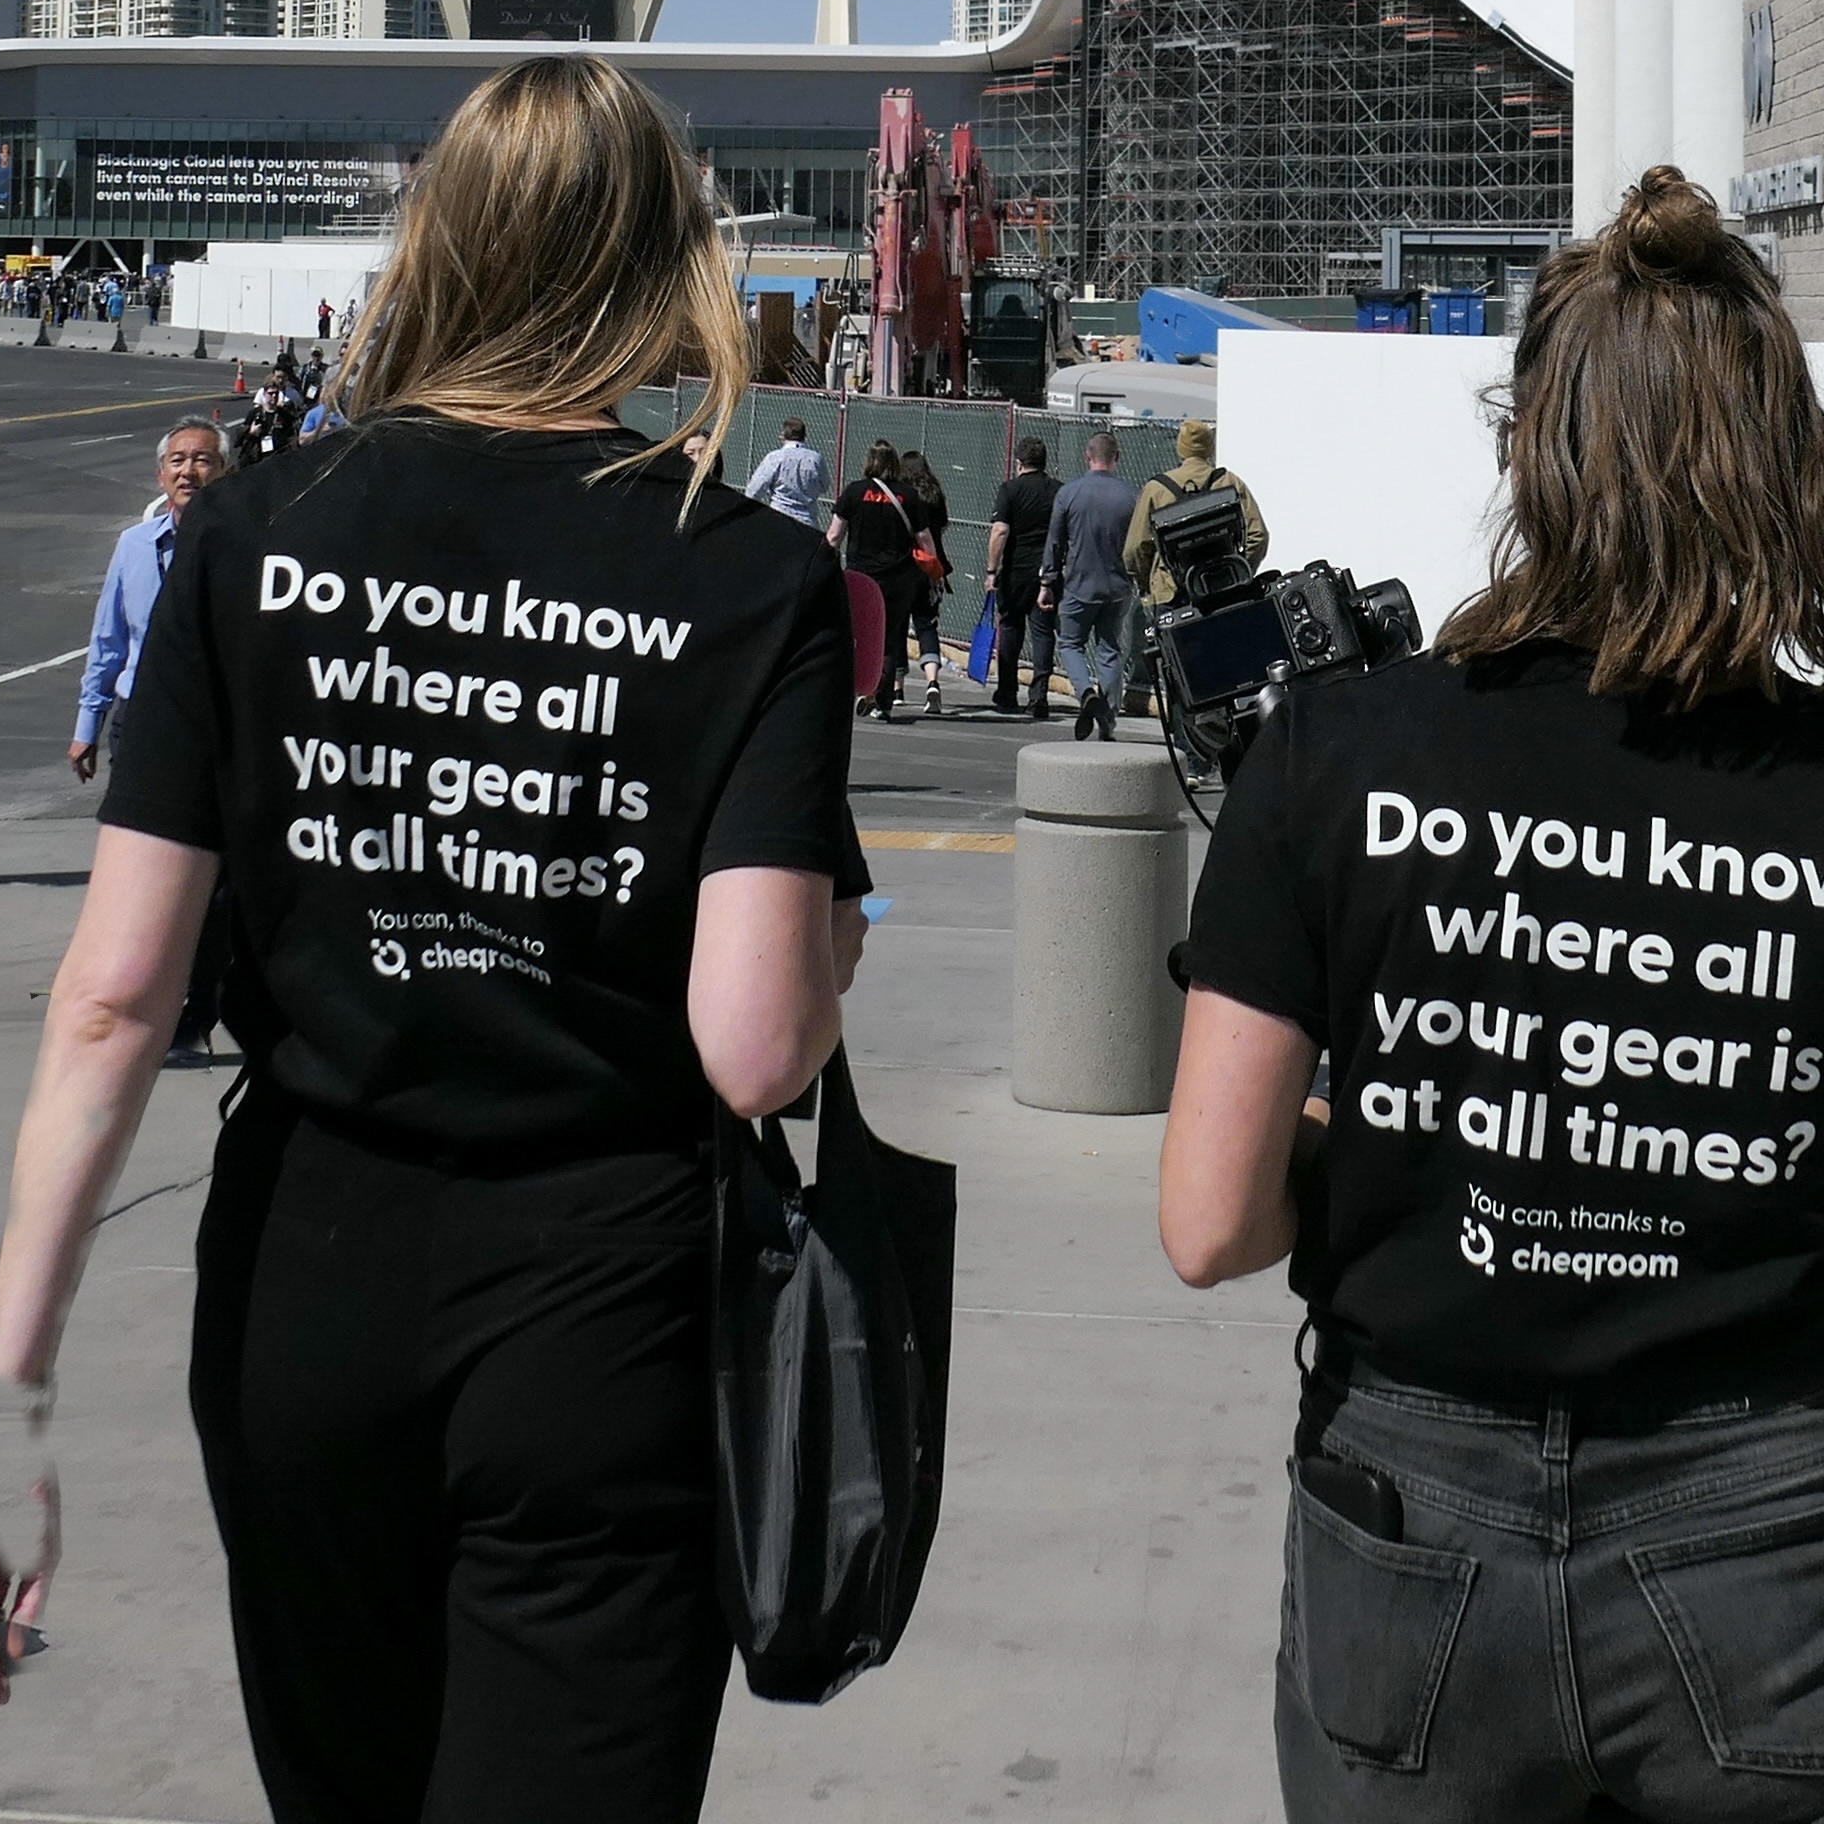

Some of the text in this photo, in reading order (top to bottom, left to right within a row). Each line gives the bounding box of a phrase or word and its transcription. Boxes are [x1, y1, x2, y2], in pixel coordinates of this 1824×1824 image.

[96, 154, 368, 173] Blackmagic Cloud lets you sync media
[96, 169, 370, 187] live from cameras to DaVinci Resolve
[96, 188, 360, 208] even while the camera is recording!
[259, 554, 692, 661] Do you know
[307, 646, 620, 735] where all
[283, 736, 650, 821] your gear is
[287, 813, 645, 904] at all times?
[1366, 790, 1467, 856] Do
[1488, 811, 1626, 877] you
[367, 908, 408, 931] You
[412, 913, 455, 933] can,
[522, 936, 545, 957] to
[421, 941, 551, 985] cheqroom
[1425, 892, 1796, 1001] where all
[1374, 991, 1824, 1093] your gear is
[1360, 1079, 1816, 1186] at all times?
[1468, 1182, 1686, 1237] You can, thanks to
[1511, 1241, 1679, 1283] cheqroom
